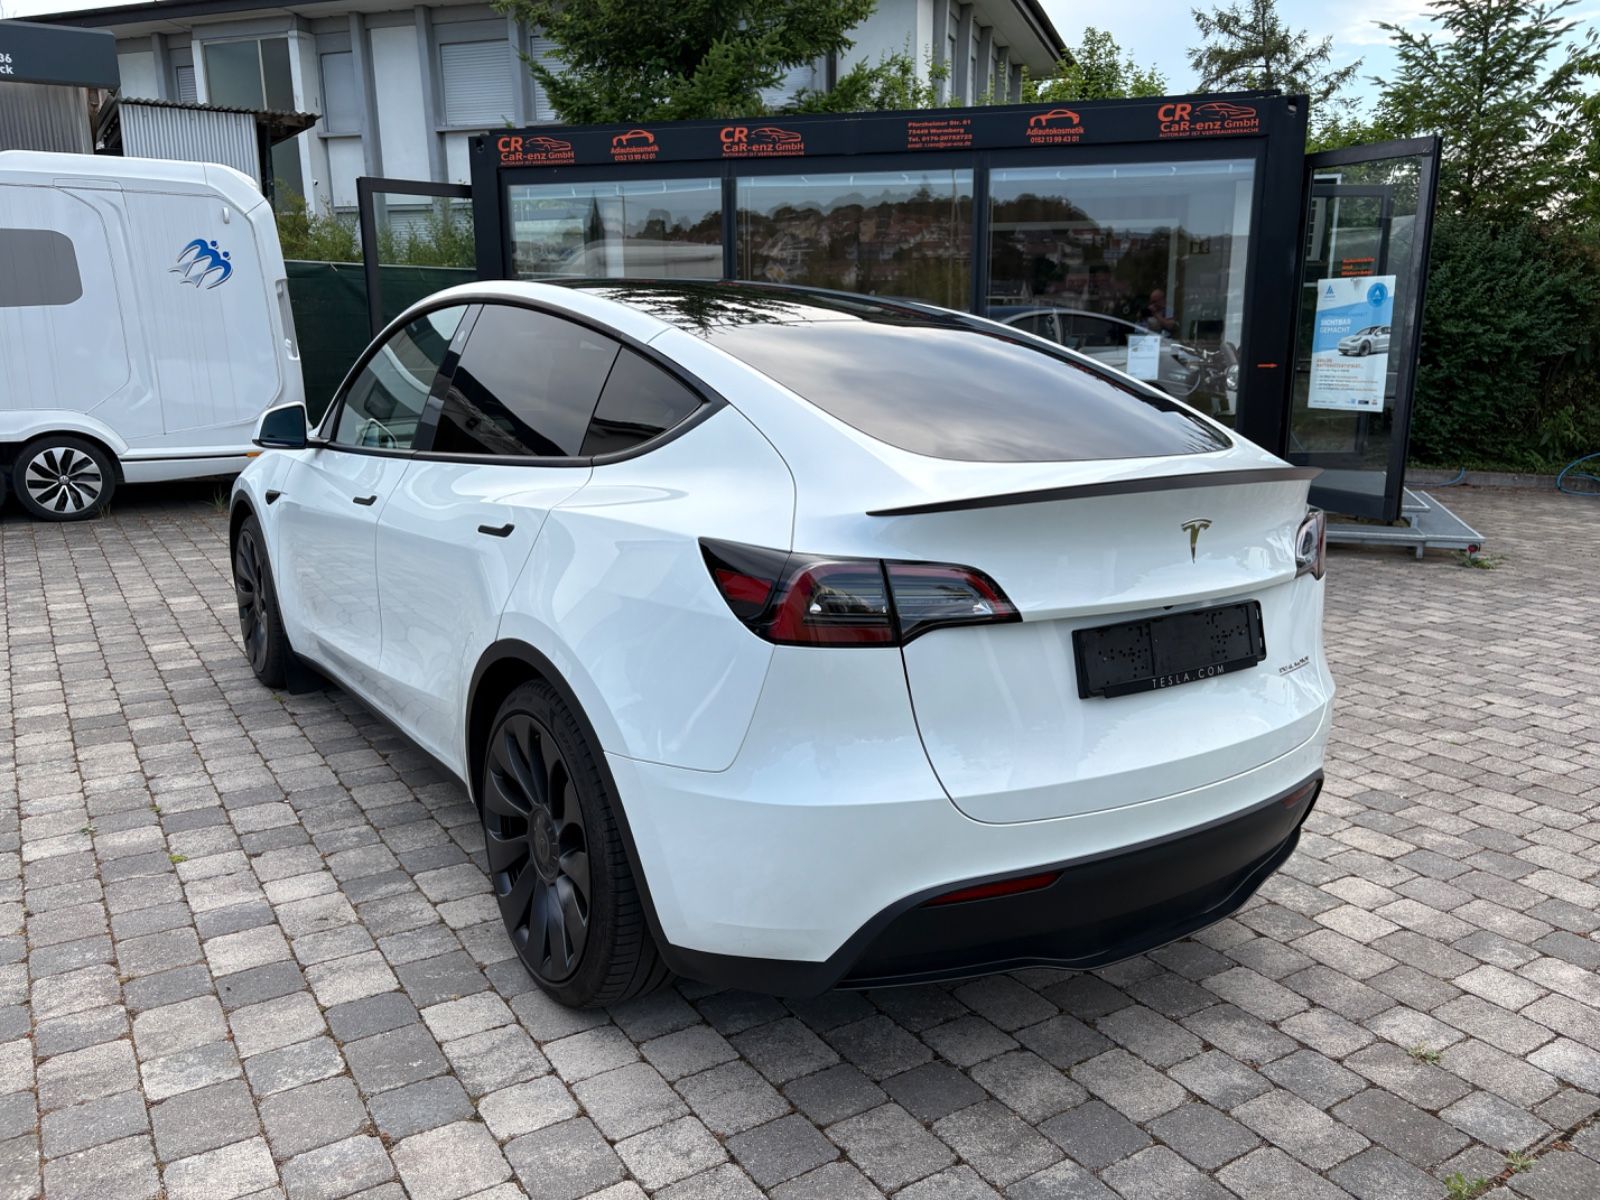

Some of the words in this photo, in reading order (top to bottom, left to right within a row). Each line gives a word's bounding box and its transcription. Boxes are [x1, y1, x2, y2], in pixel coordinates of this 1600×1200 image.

[1157, 103, 1192, 121] CR
[1160, 121, 1221, 132] CaR-enz
[1224, 118, 1259, 129] GmbH
[720, 127, 748, 142] CR
[497, 136, 523, 152] CR
[723, 142, 773, 152] CaR-enz
[775, 142, 804, 151] GmbH
[501, 151, 546, 161] CaR-enz
[548, 151, 575, 159] GmbH
[1152, 664, 1225, 689] TESLA.COM
